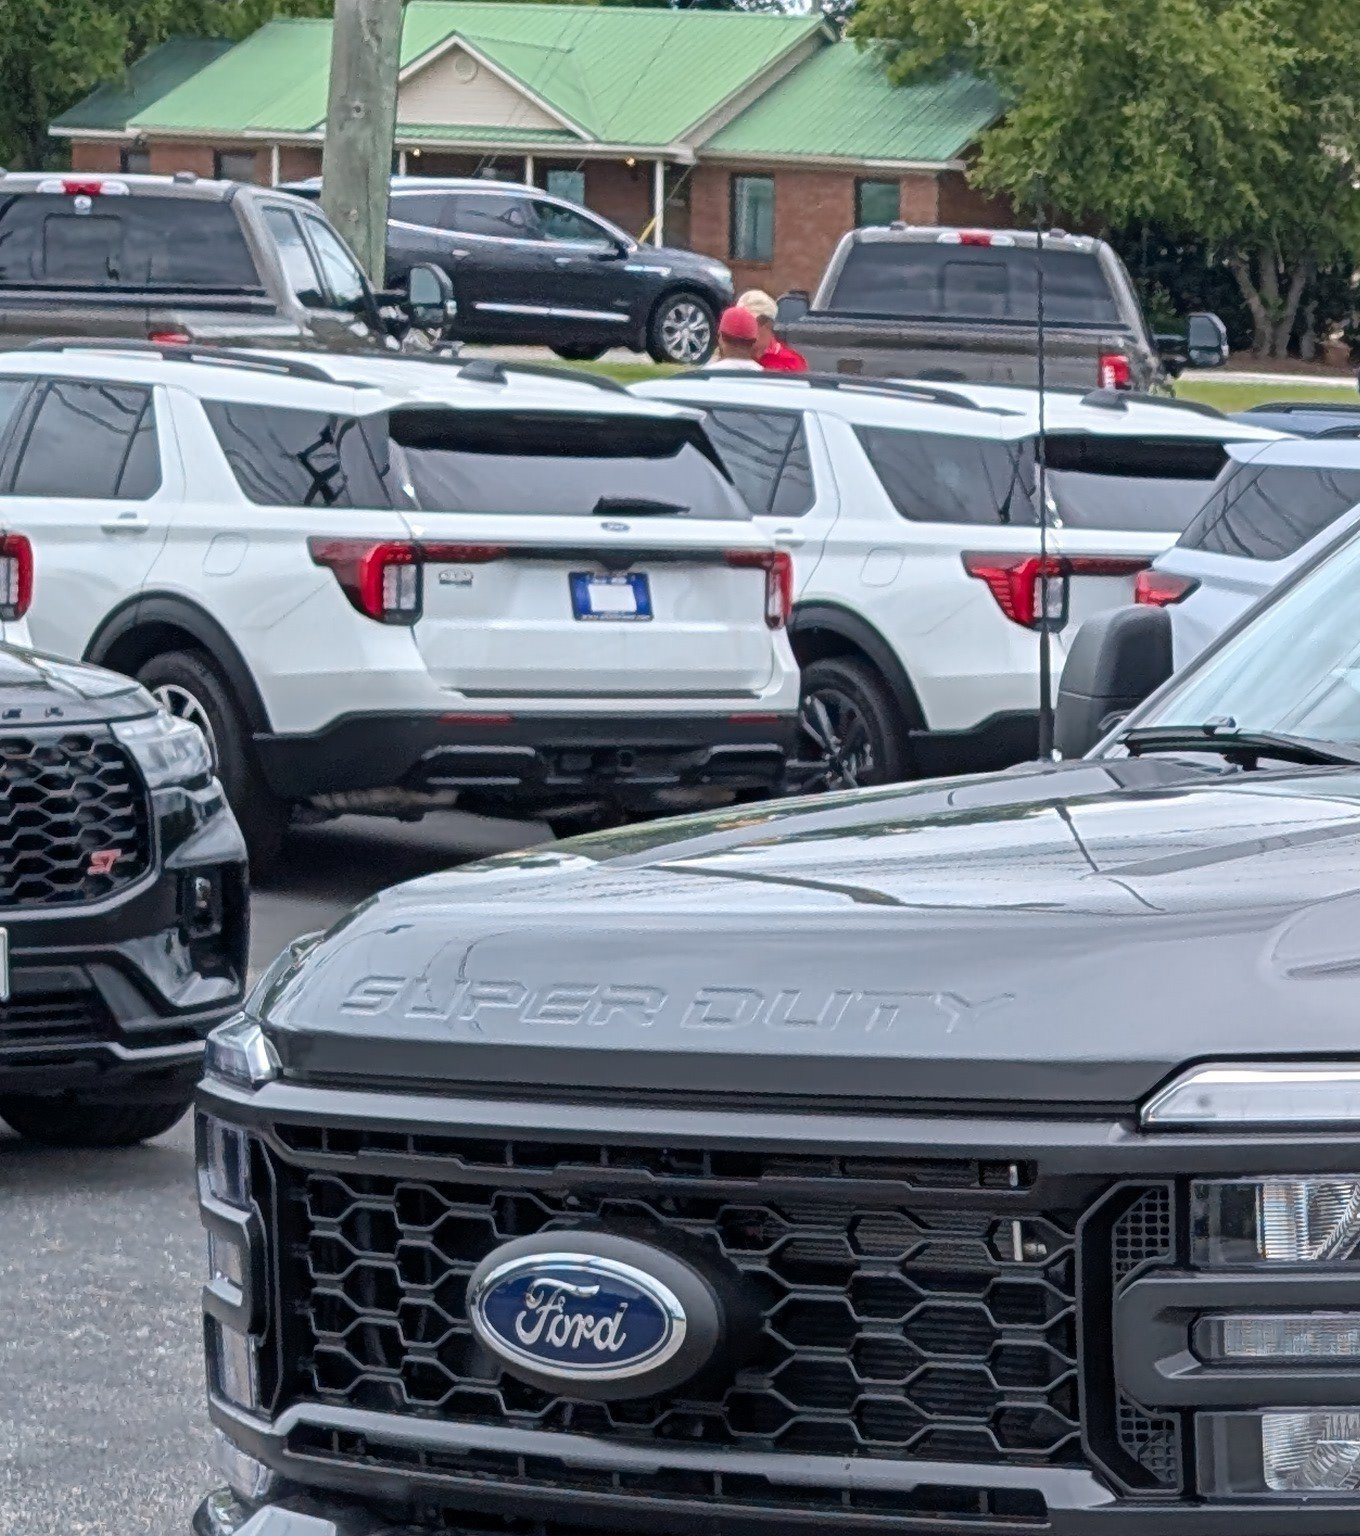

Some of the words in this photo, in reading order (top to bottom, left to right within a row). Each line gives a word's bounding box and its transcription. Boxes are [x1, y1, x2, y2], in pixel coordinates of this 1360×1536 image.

[340, 973, 670, 1028] SUPER
[680, 986, 1017, 1035] DUTY
[514, 1277, 629, 1353] Ford
